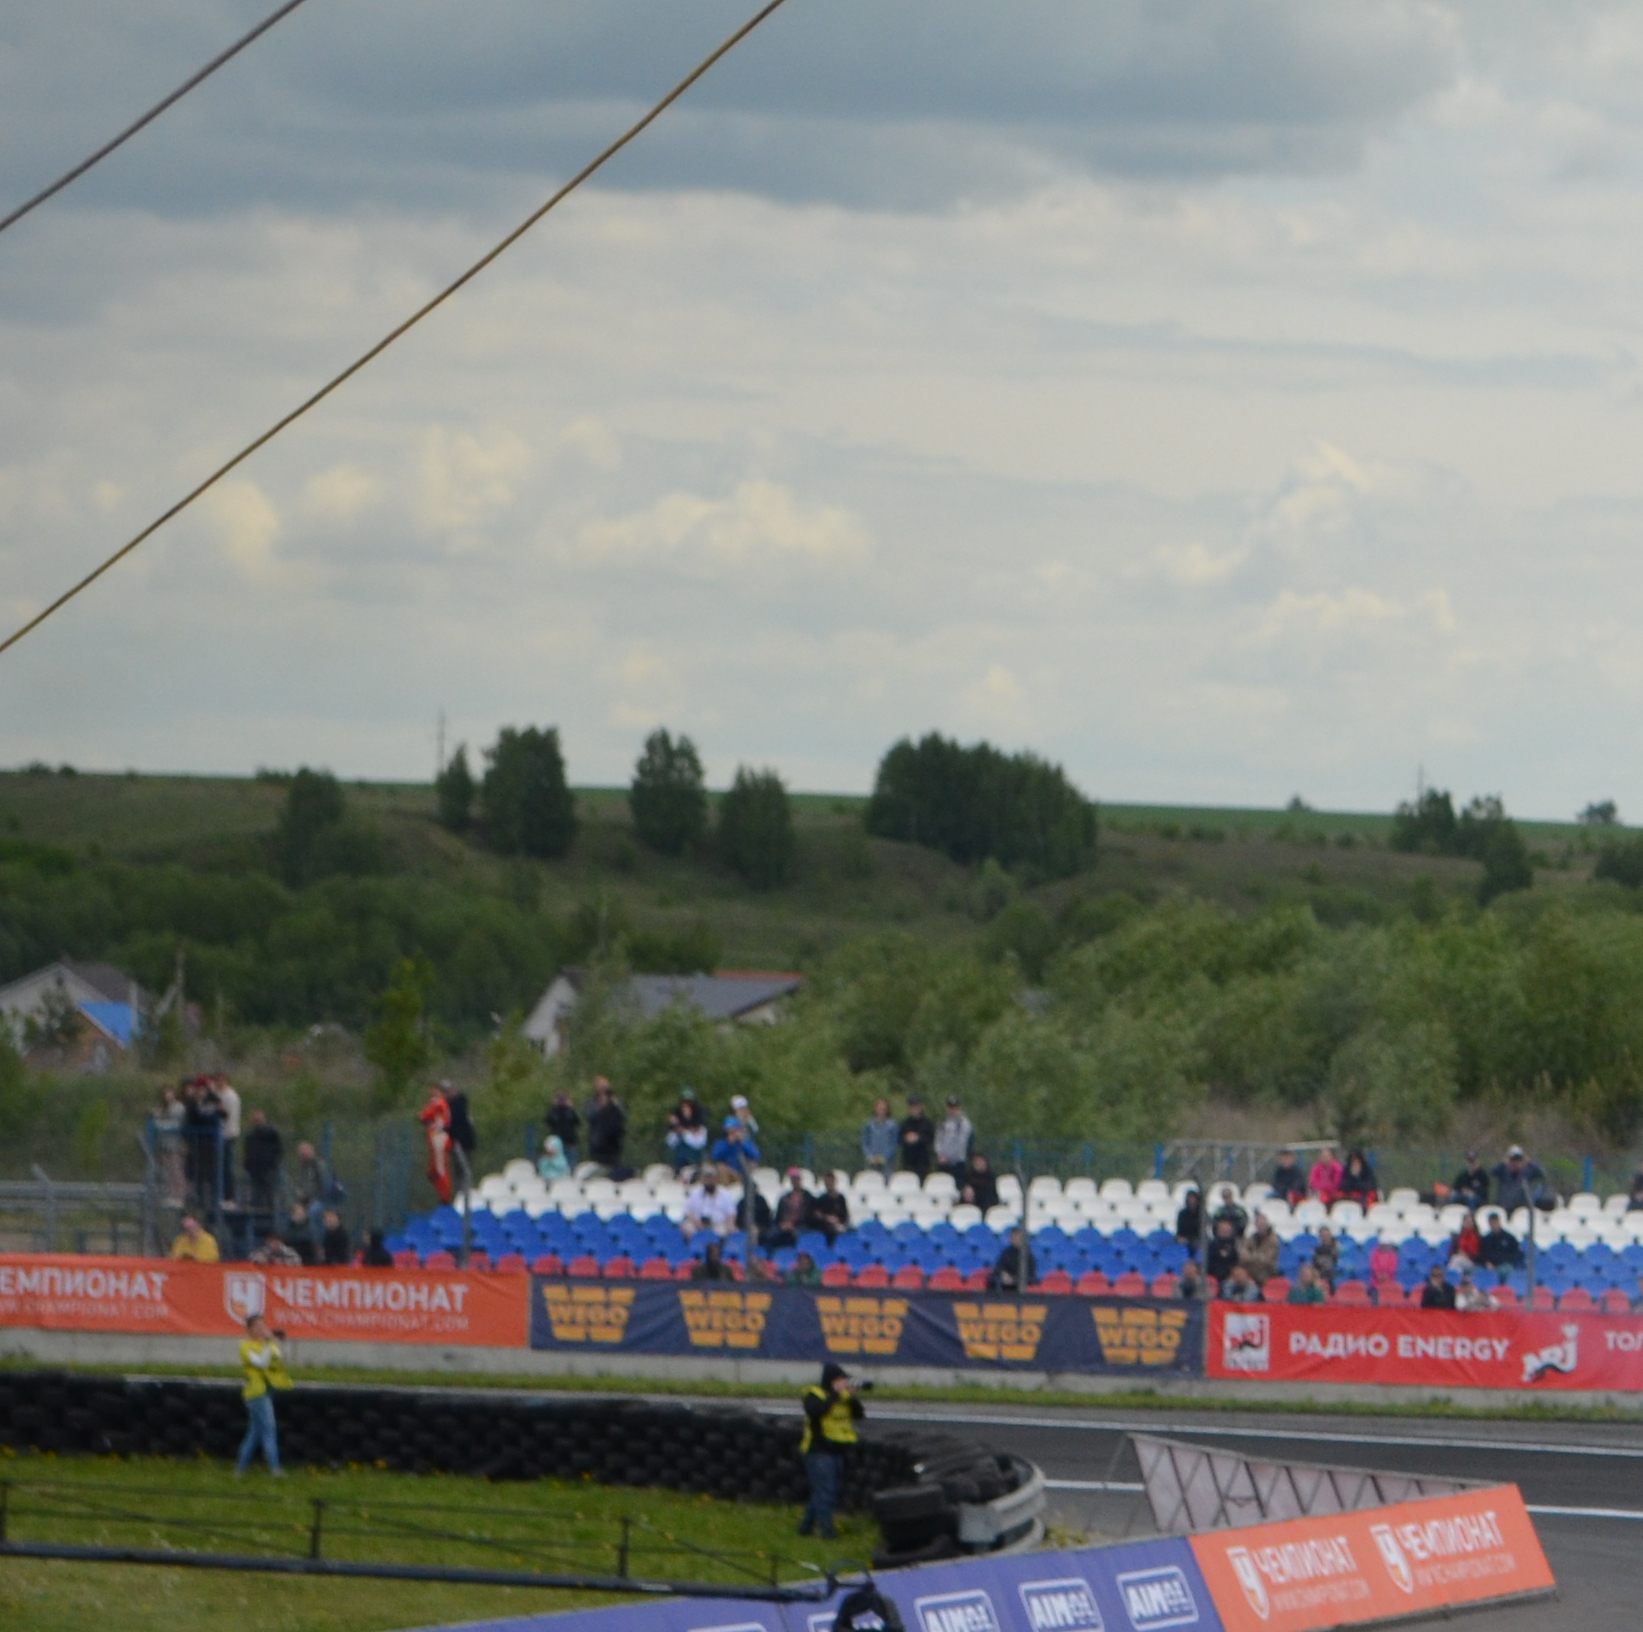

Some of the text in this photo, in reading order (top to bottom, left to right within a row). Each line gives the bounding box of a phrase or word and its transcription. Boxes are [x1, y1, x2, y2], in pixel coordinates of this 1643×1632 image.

[0, 1266, 169, 1301] ЕМПИОНАТ
[272, 1277, 470, 1313] ЧЕМПИОНАТ
[549, 1304, 630, 1326] WEGO
[684, 1307, 767, 1332] WEGO
[821, 1315, 904, 1339] WEGO
[958, 1319, 1042, 1344] WEGO
[1097, 1325, 1182, 1349] WEGO
[1289, 1332, 1510, 1362] РАДИО ENERGY
[1396, 1510, 1505, 1560] ЧЕМПИОНАТ
[1253, 1536, 1358, 1584] ЧЕМПИОНАТ
[1028, 1591, 1099, 1629] AIMOL
[1126, 1579, 1194, 1619] AIMOL
